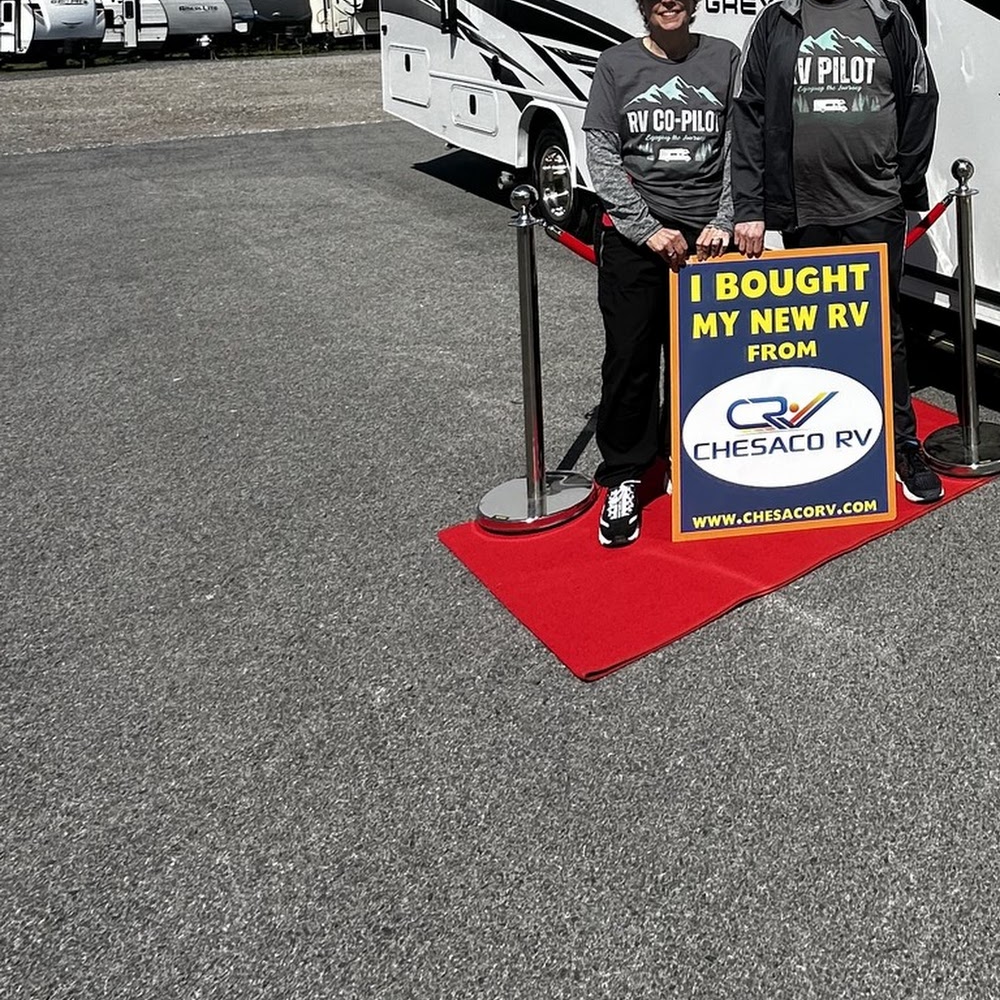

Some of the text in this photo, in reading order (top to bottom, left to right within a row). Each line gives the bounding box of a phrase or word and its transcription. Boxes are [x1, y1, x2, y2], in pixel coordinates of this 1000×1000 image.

[818, 56, 876, 84] PILOT
[627, 110, 649, 133] RV
[690, 264, 870, 302] I BOUGHT
[692, 301, 869, 339] MY NEW RV
[747, 340, 817, 362] FROM
[693, 428, 872, 461] CHESACO RV
[692, 500, 877, 529] WWW.CHESACORV.COM
